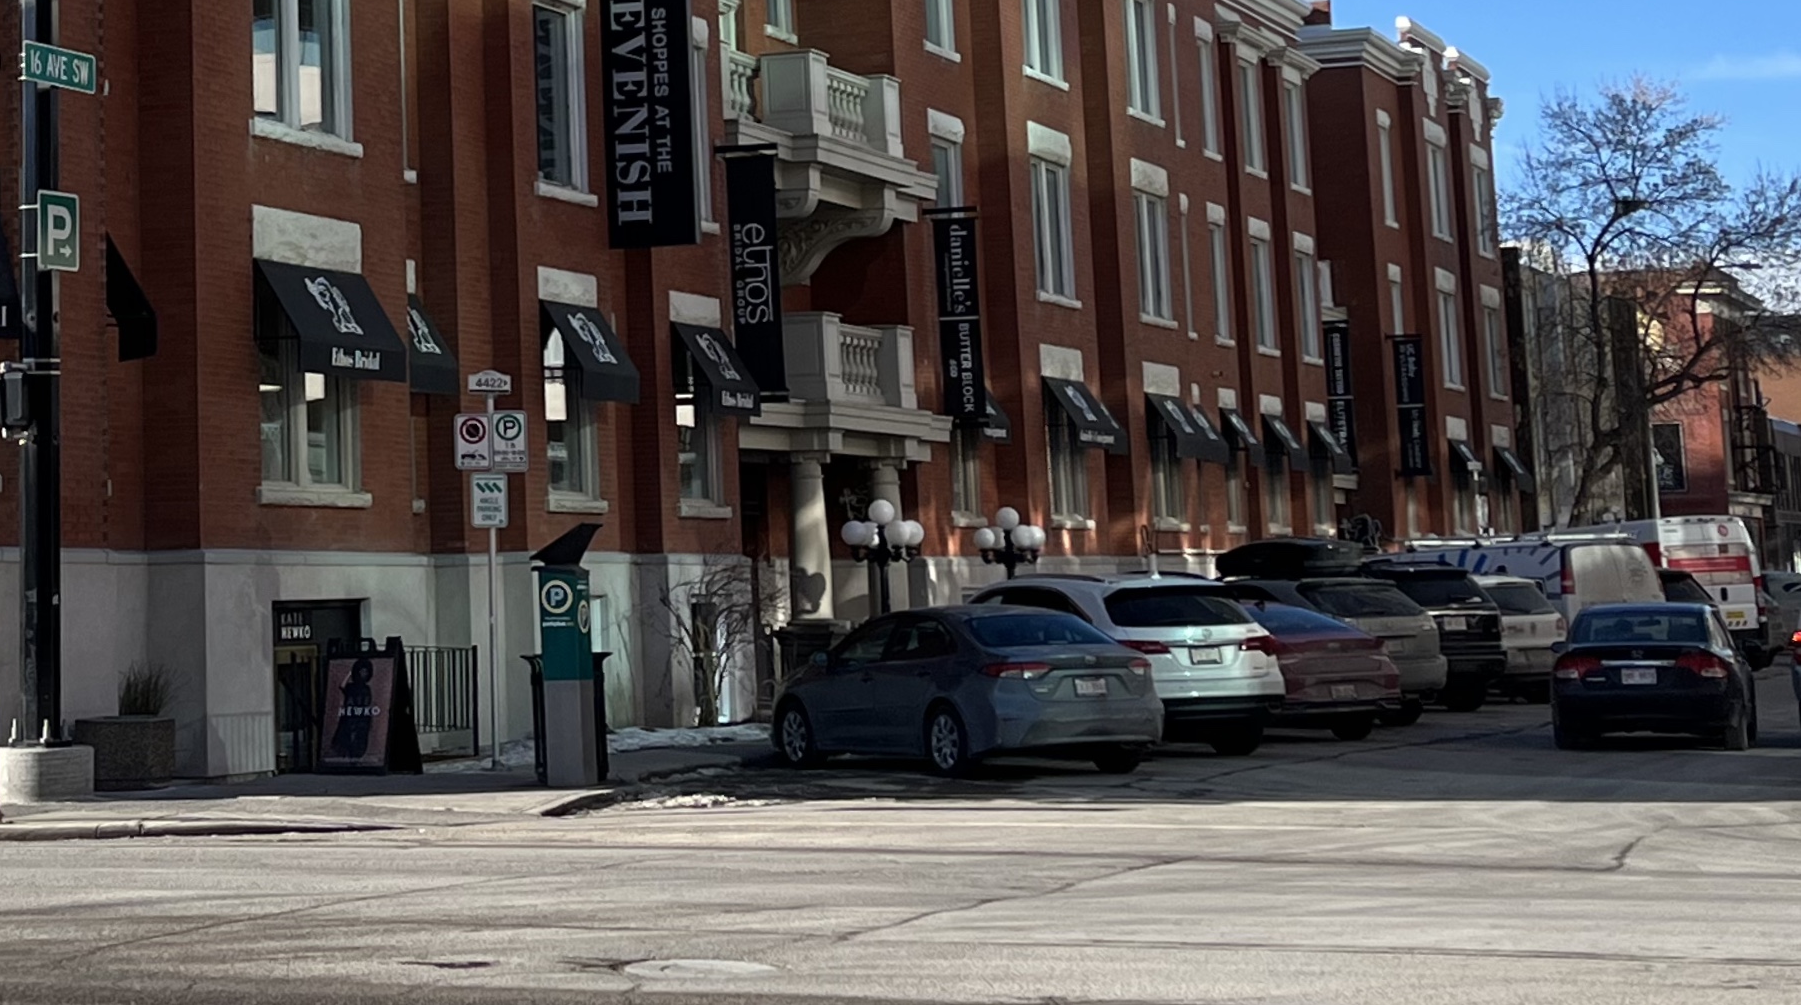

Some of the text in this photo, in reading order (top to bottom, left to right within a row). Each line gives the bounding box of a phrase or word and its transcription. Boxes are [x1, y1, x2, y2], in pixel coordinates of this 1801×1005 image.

[29, 49, 89, 86] 16 AVE SW
[651, 7, 673, 174] SHOPPES AT THE
[47, 204, 72, 256] P
[733, 224, 746, 324] BRIDAL GROUP
[949, 224, 972, 313] danielle's
[475, 377, 503, 388] 4422
[958, 322, 975, 413] BUTTER BLOCK
[281, 625, 311, 640] HEWKO
[338, 706, 381, 718] HEWKO
